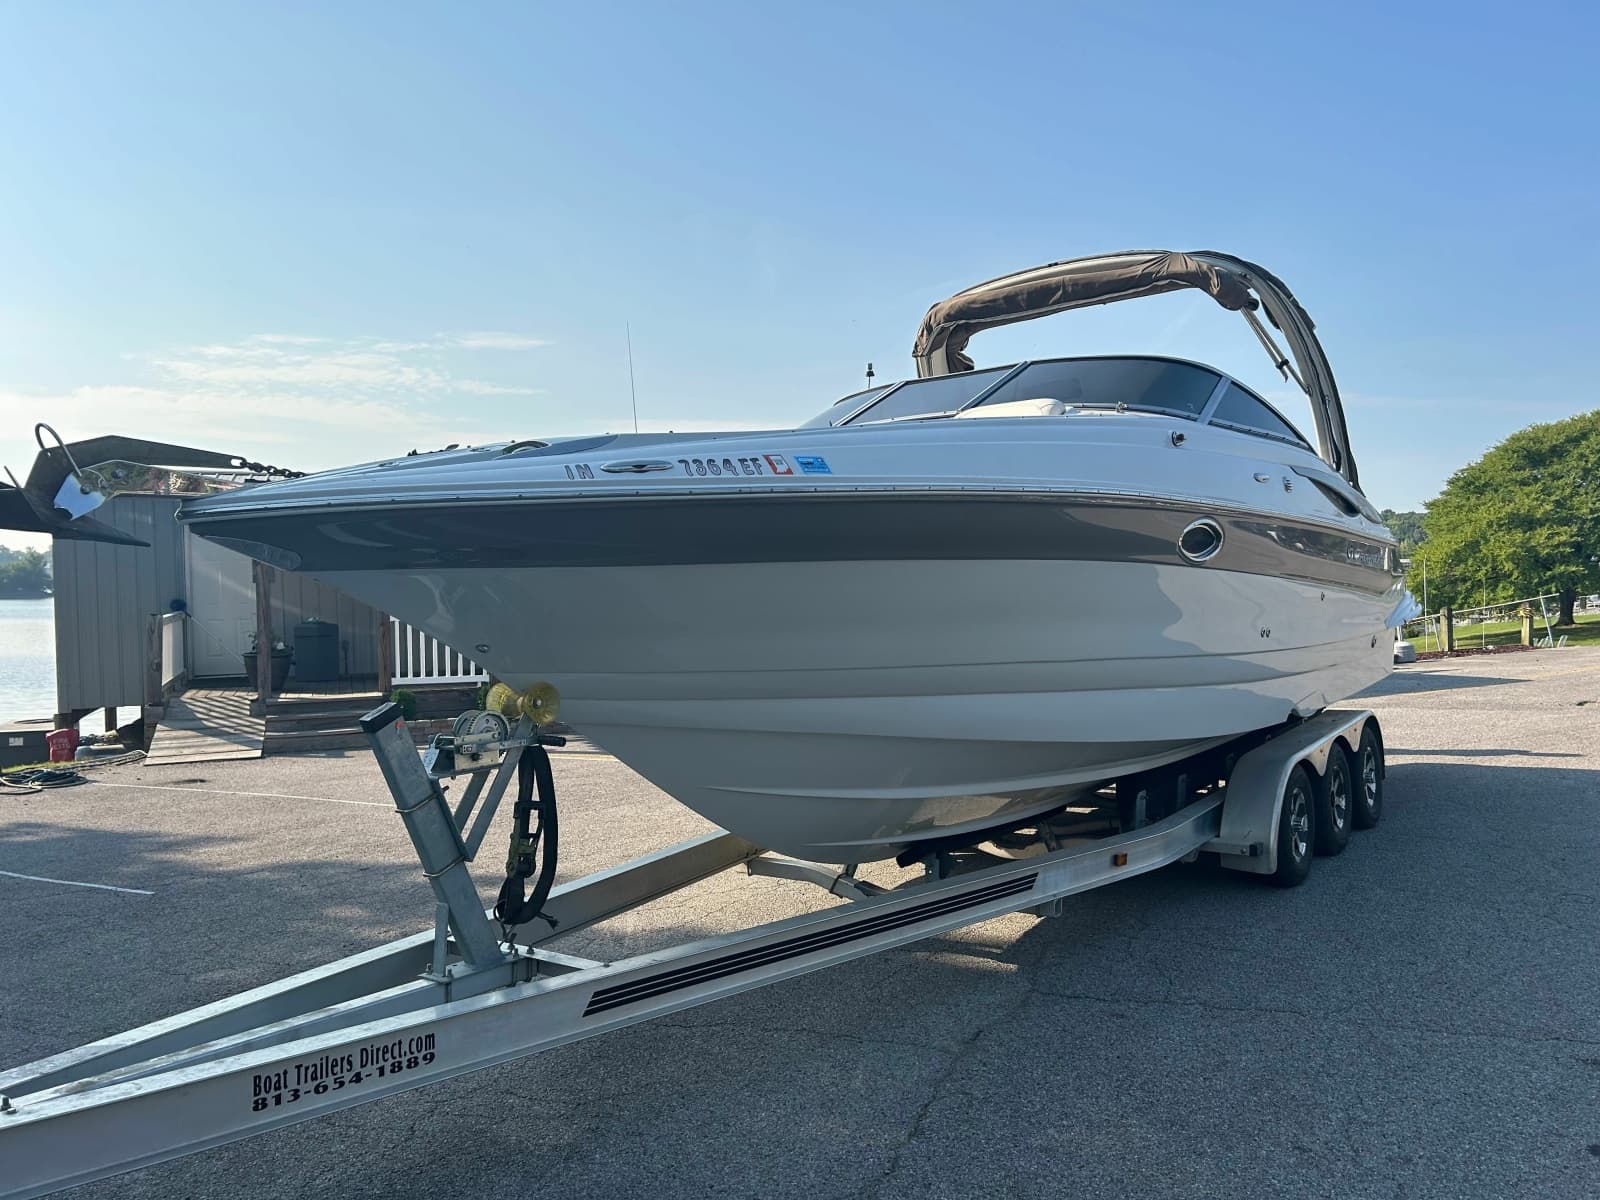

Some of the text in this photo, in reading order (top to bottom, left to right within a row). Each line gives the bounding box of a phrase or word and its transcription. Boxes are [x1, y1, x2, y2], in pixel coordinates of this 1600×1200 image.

[564, 463, 595, 480] IN
[252, 1051, 436, 1112] 813-654-1889
[253, 1032, 436, 1098] Boat Trailers Direct.com
